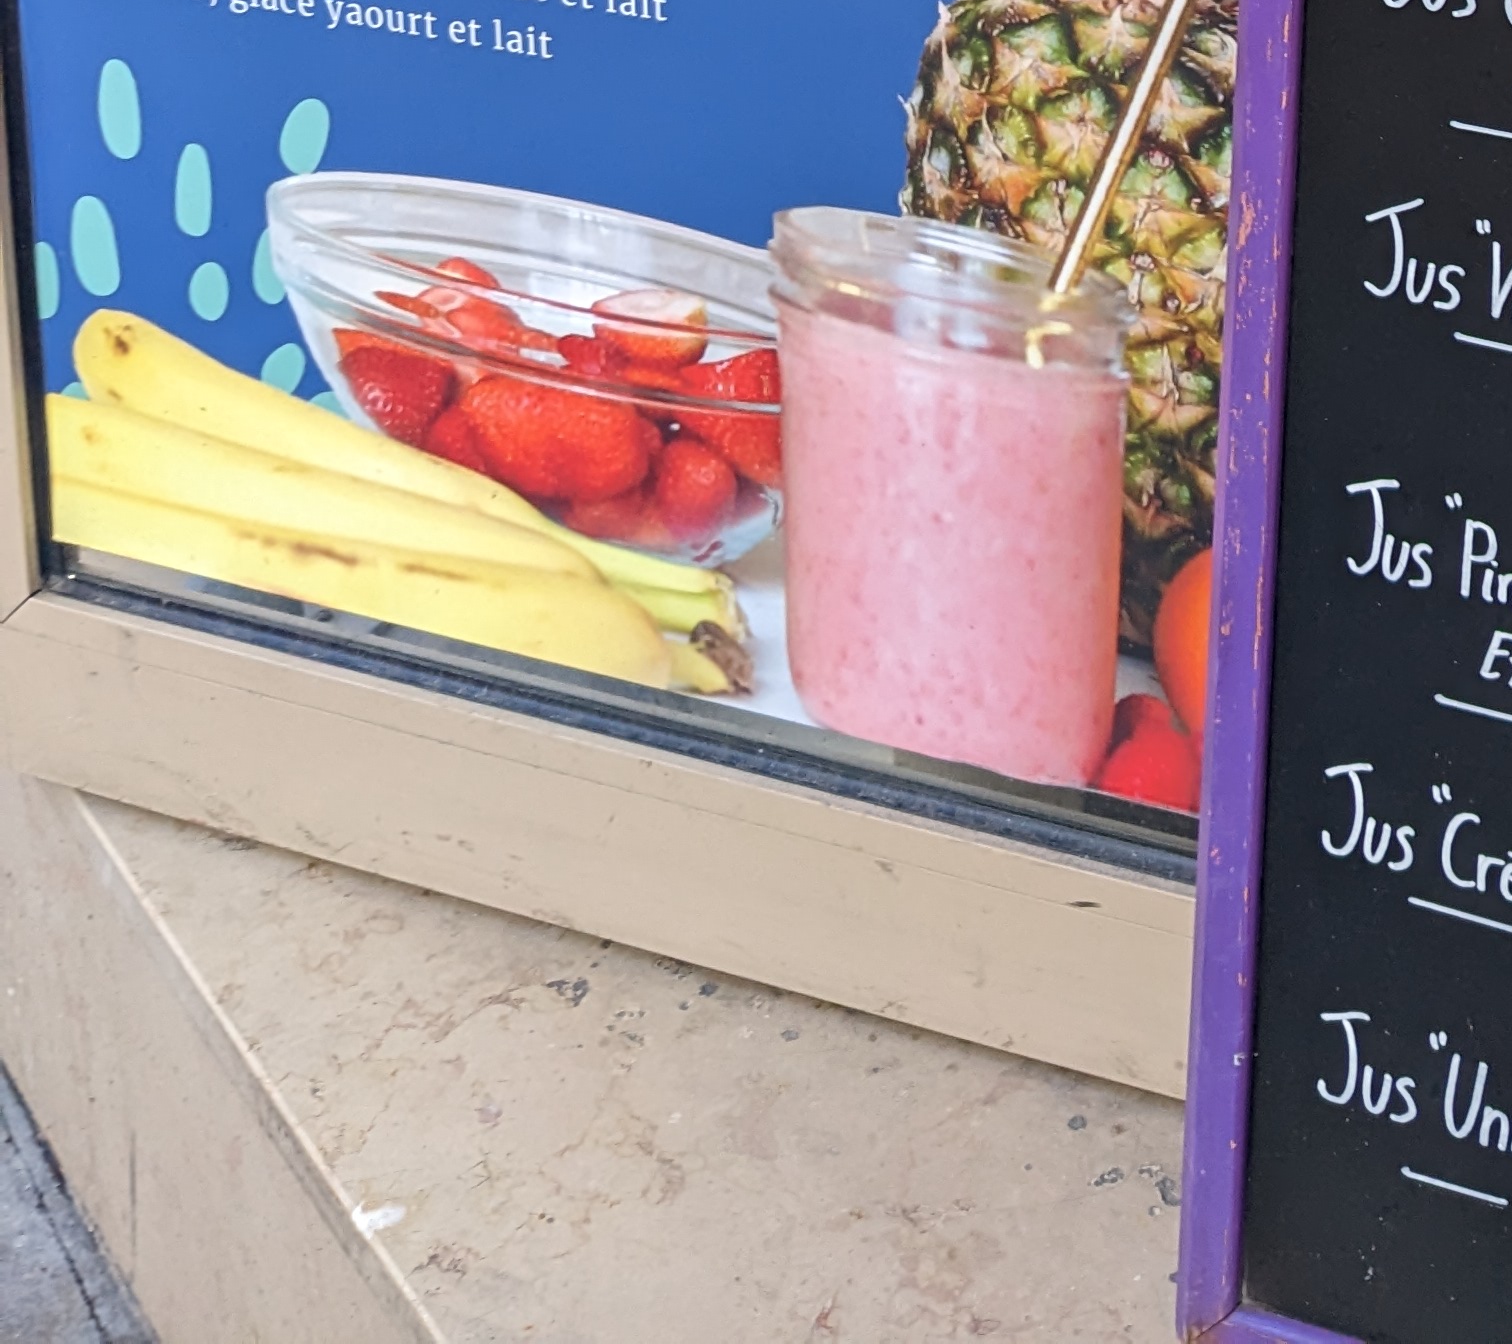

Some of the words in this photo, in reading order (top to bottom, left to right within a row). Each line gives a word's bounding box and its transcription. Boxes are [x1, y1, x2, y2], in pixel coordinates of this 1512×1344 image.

[448, 19, 483, 47] et
[492, 18, 554, 59] lait
[1363, 198, 1466, 311] Jus
[1345, 478, 1433, 588] Jus
[1321, 762, 1416, 872] Jus
[1316, 1011, 1418, 1124] Jus
